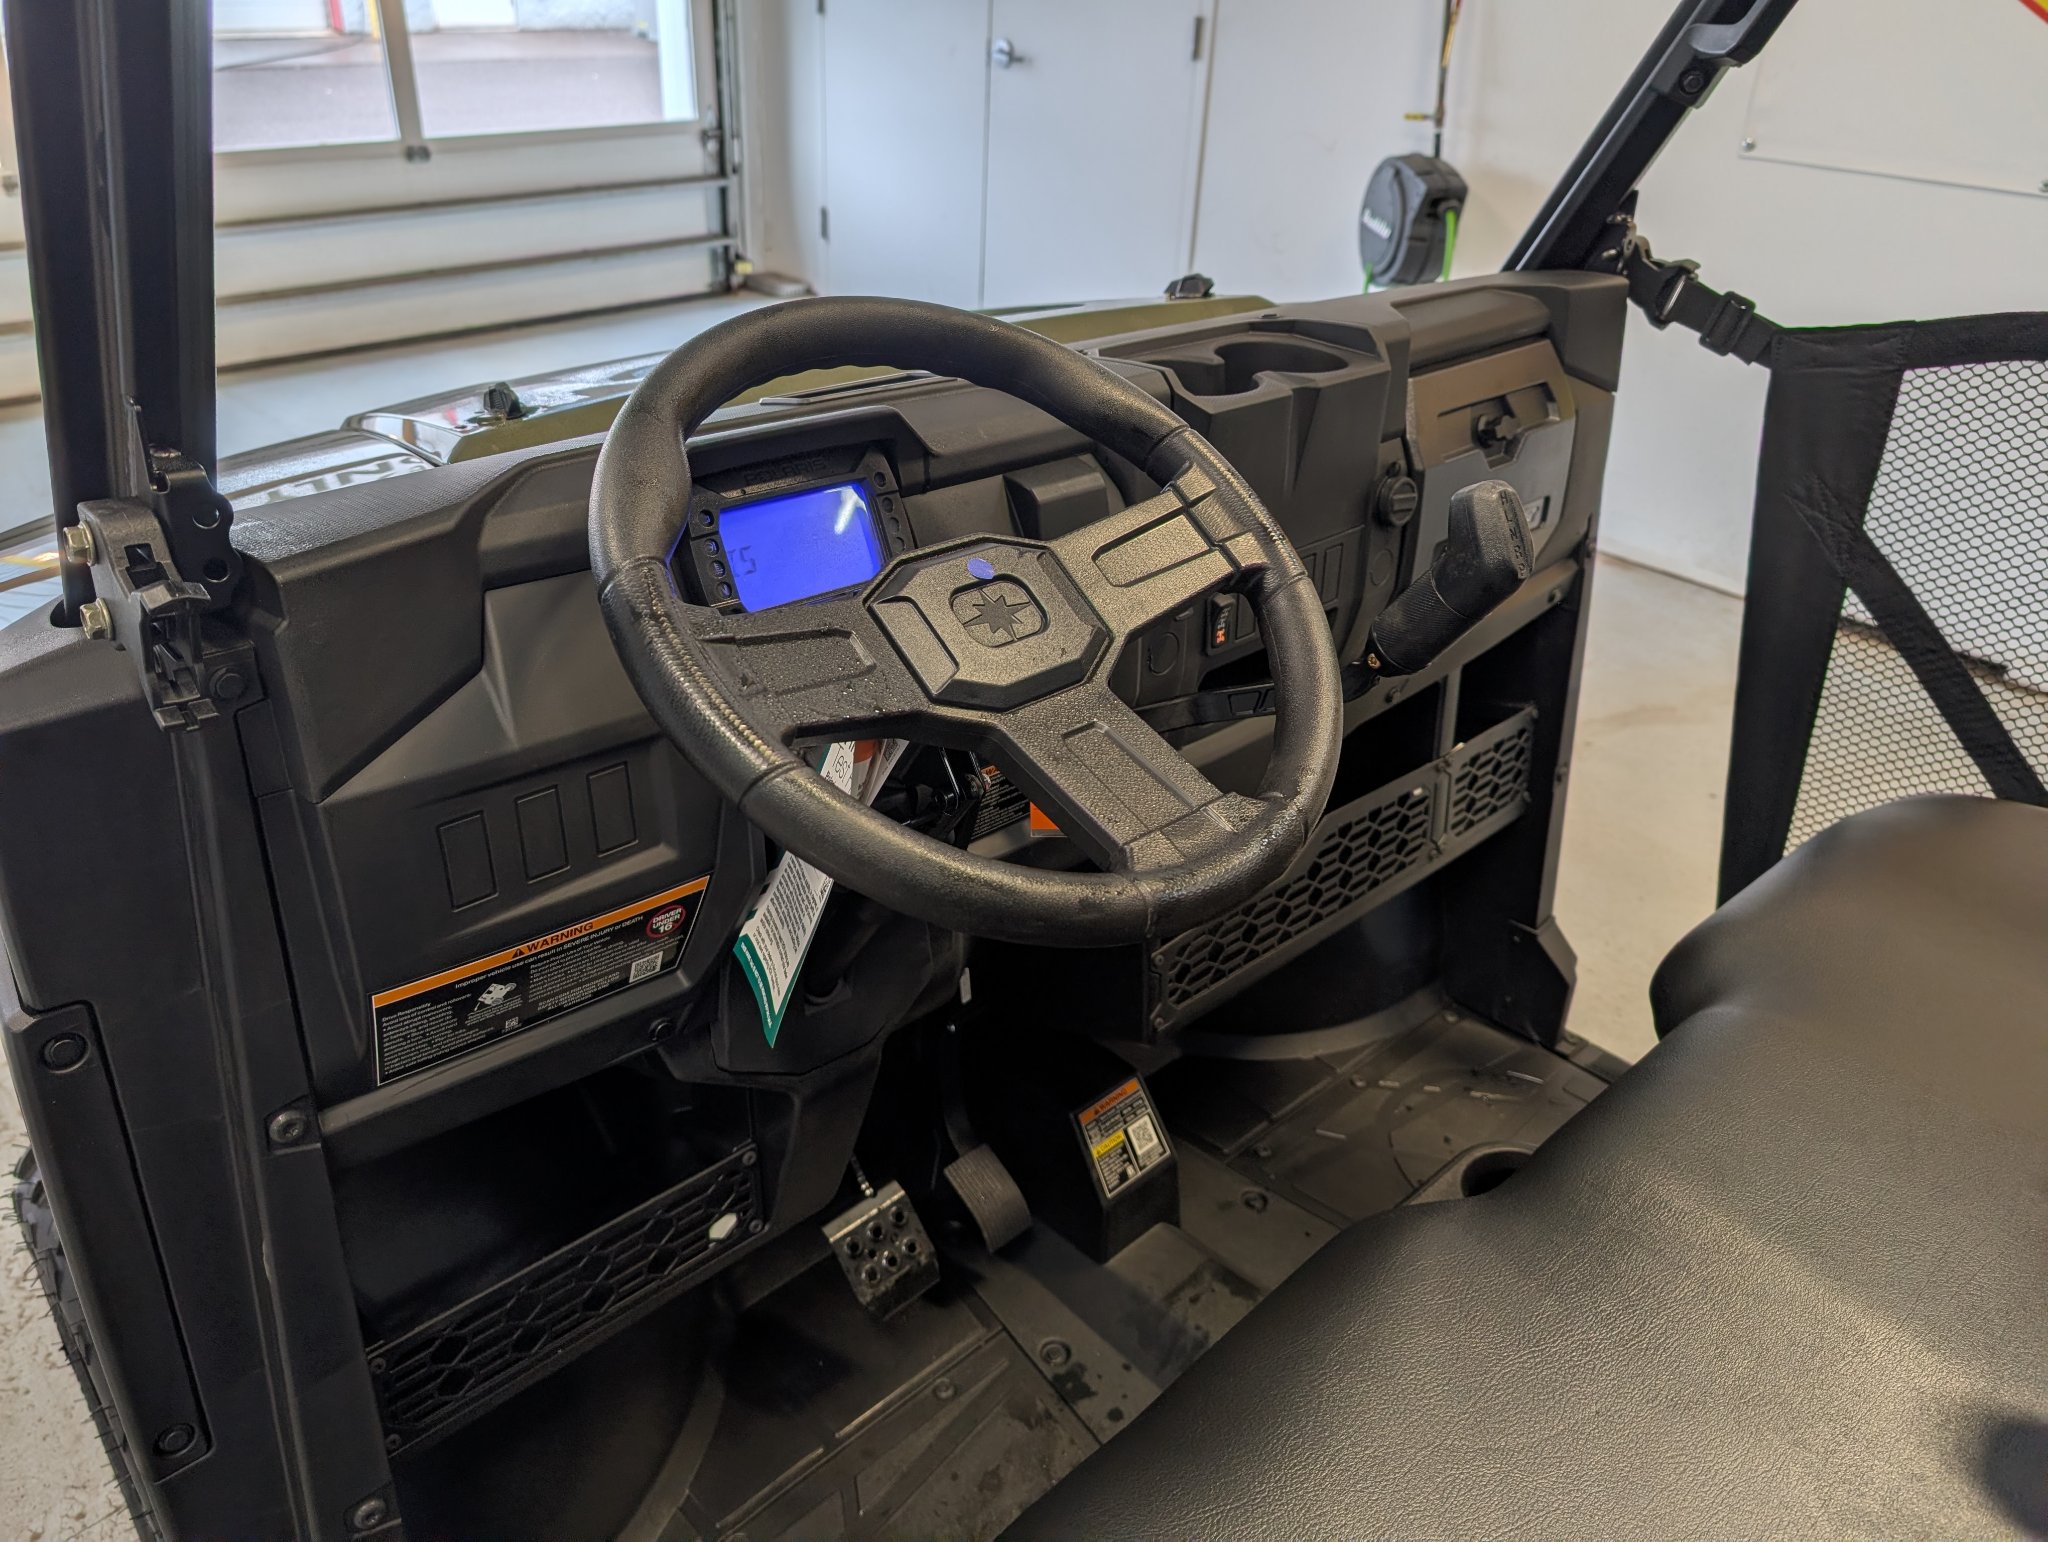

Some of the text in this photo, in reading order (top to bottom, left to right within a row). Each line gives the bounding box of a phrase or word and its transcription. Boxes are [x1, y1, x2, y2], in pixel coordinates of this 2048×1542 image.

[653, 908, 681, 923] DRIVER
[653, 914, 680, 928] UNDER
[659, 922, 672, 933] 16
[527, 923, 593, 951] WARNING
[455, 974, 486, 988] Improper
[487, 965, 511, 977] vehicle
[537, 949, 555, 958] result
[563, 936, 589, 949] SEVERE
[590, 926, 615, 939] INJURY
[622, 916, 643, 927] DEATH
